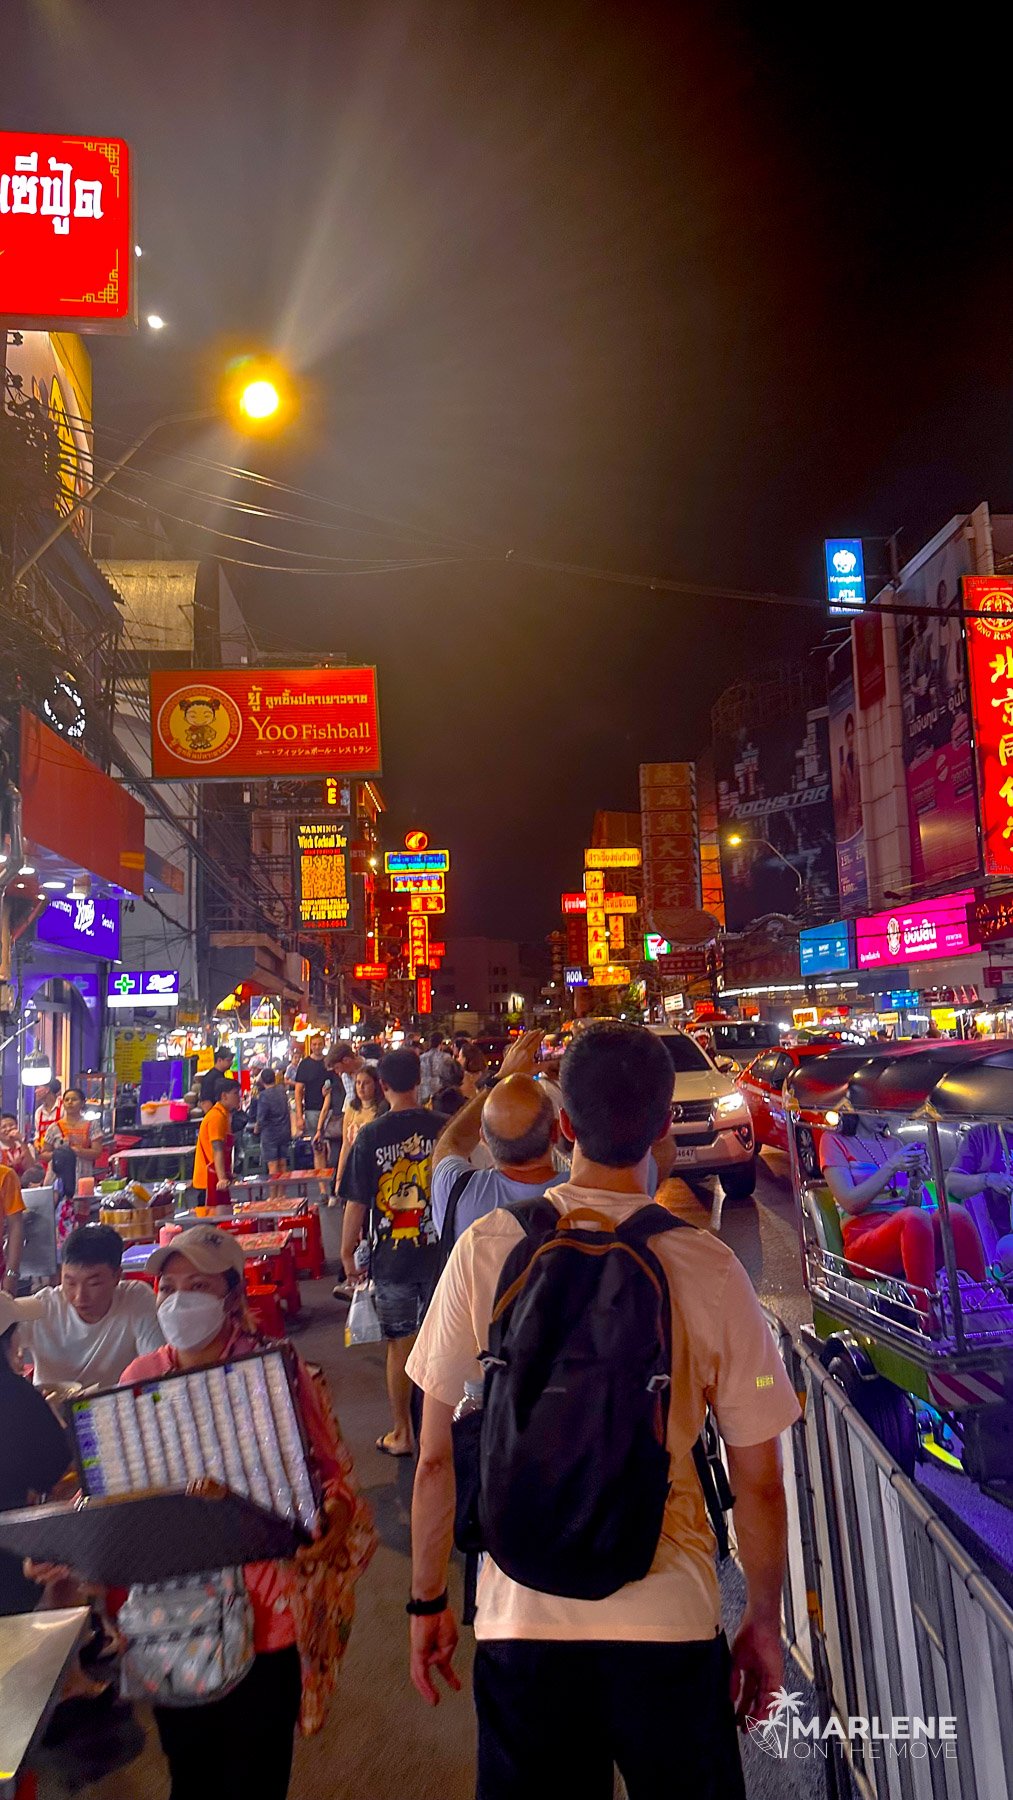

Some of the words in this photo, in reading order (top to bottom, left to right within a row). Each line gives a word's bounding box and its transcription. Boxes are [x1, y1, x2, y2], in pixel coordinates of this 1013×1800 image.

[0, 151, 104, 235] ซีฟู้ด
[301, 722, 371, 740] Fishball
[49, 900, 73, 917] harmacy
